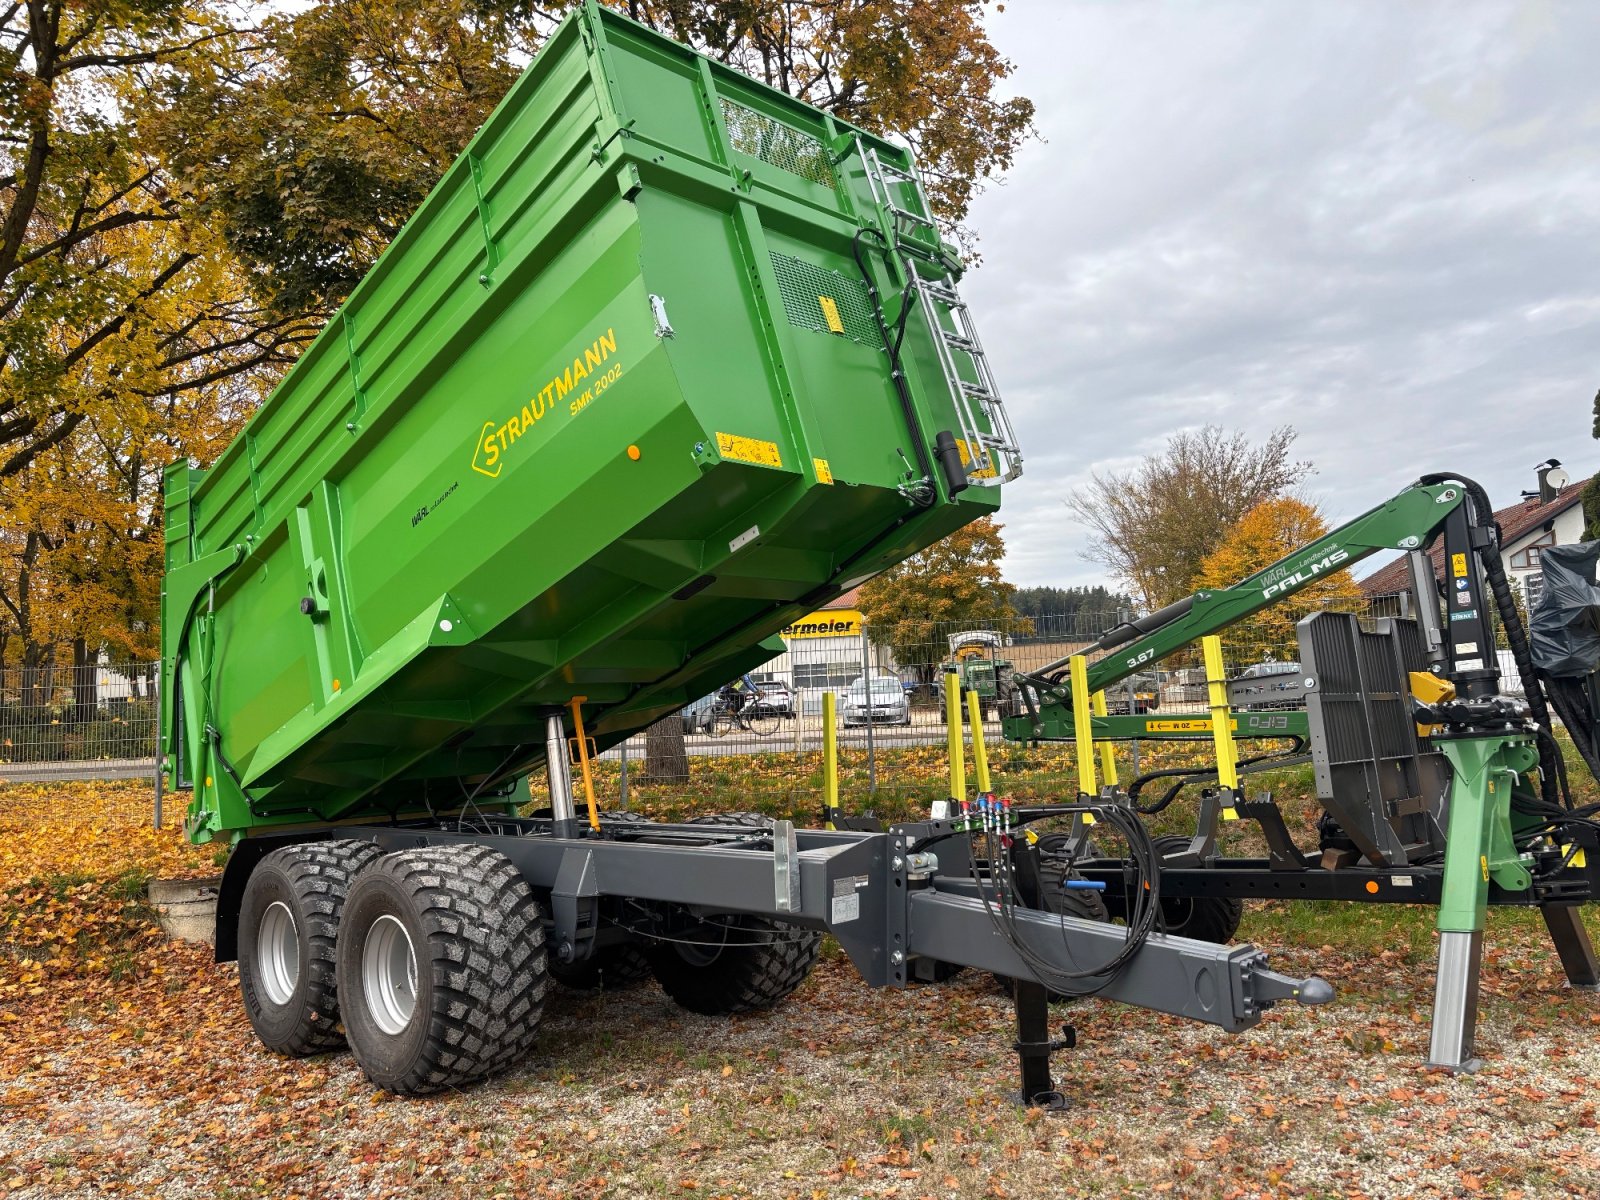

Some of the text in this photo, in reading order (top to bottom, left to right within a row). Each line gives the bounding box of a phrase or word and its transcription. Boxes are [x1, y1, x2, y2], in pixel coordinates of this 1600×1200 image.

[482, 327, 617, 466] STRAUTMANN
[569, 362, 623, 416] SMK 2002
[1260, 542, 1339, 588] WÄRL Landtechnik
[1262, 548, 1349, 600] PALMS
[1126, 648, 1155, 668] 3.67
